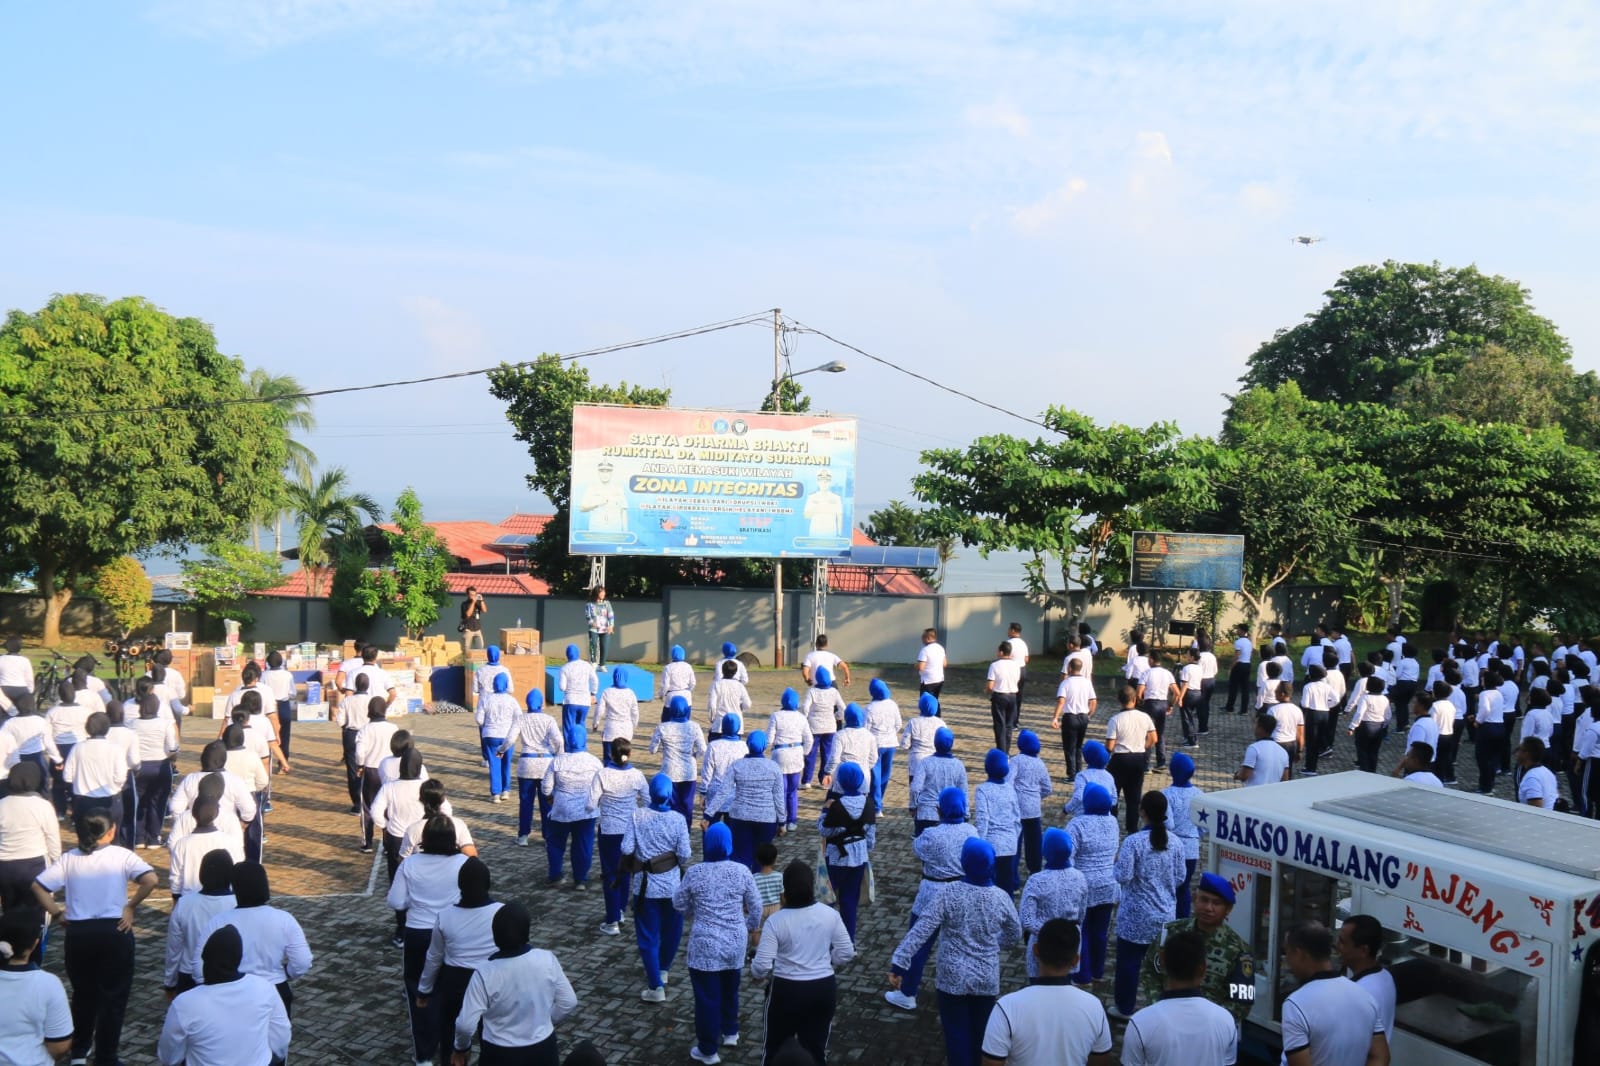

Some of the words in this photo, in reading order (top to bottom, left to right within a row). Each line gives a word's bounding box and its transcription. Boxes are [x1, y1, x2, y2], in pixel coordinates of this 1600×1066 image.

[631, 433, 679, 447] SATYA
[683, 437, 749, 450] DHARMA
[753, 440, 809, 453] BHAKTI
[602, 446, 674, 459] RUMKITAL
[677, 450, 695, 460] Dr.
[700, 451, 763, 464] MIDIYATO
[767, 454, 831, 466] SURATANI
[642, 462, 677, 474] ANDA
[678, 465, 739, 476] MEMASUKI
[742, 468, 793, 479] WILAYAH
[633, 477, 689, 494] ZONA
[693, 480, 798, 498] INTEGRITAS
[1216, 809, 1288, 857] BAKSO
[1294, 830, 1401, 889] MALANG
